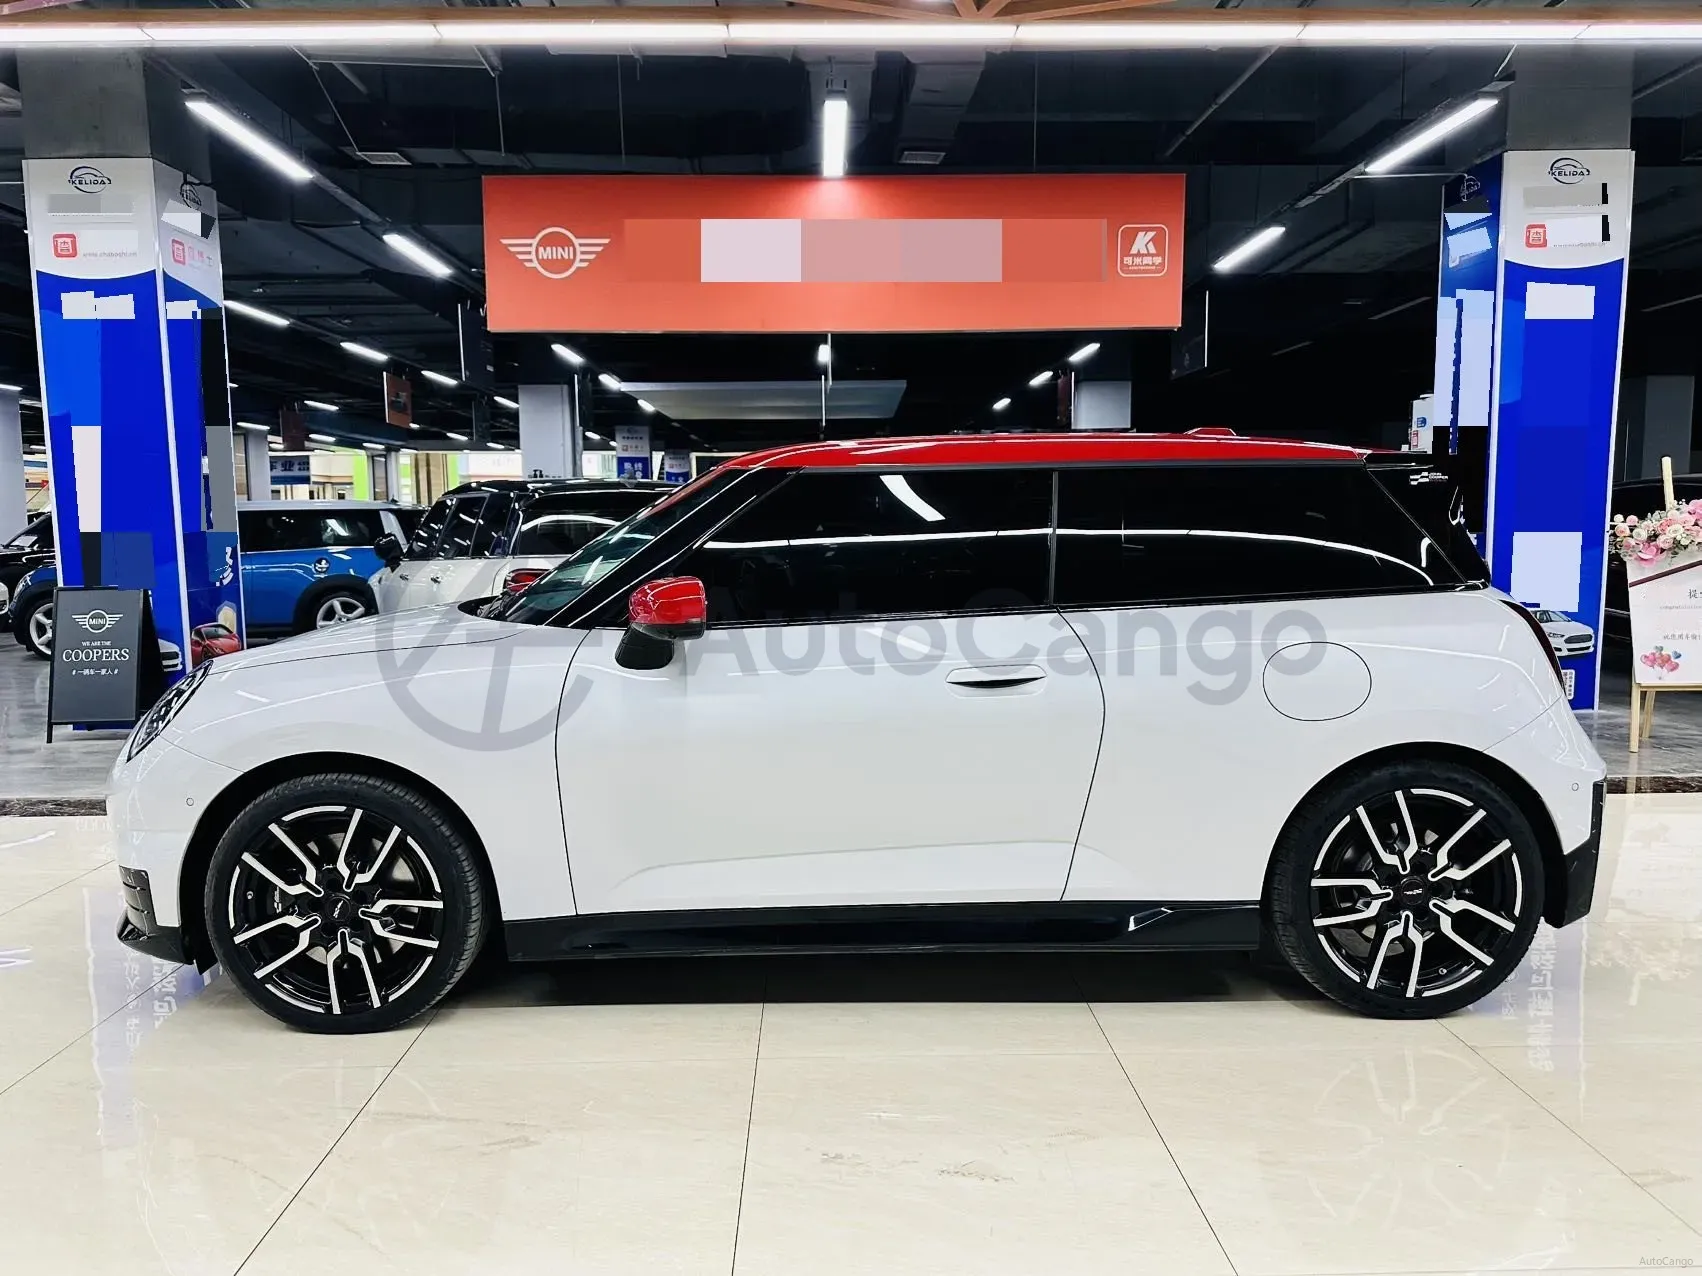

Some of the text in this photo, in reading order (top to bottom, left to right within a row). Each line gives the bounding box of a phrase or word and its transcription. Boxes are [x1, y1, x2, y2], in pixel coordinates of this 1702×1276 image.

[538, 246, 574, 260] MINI
[88, 617, 106, 625] MINI
[62, 648, 130, 662] COOPERS
